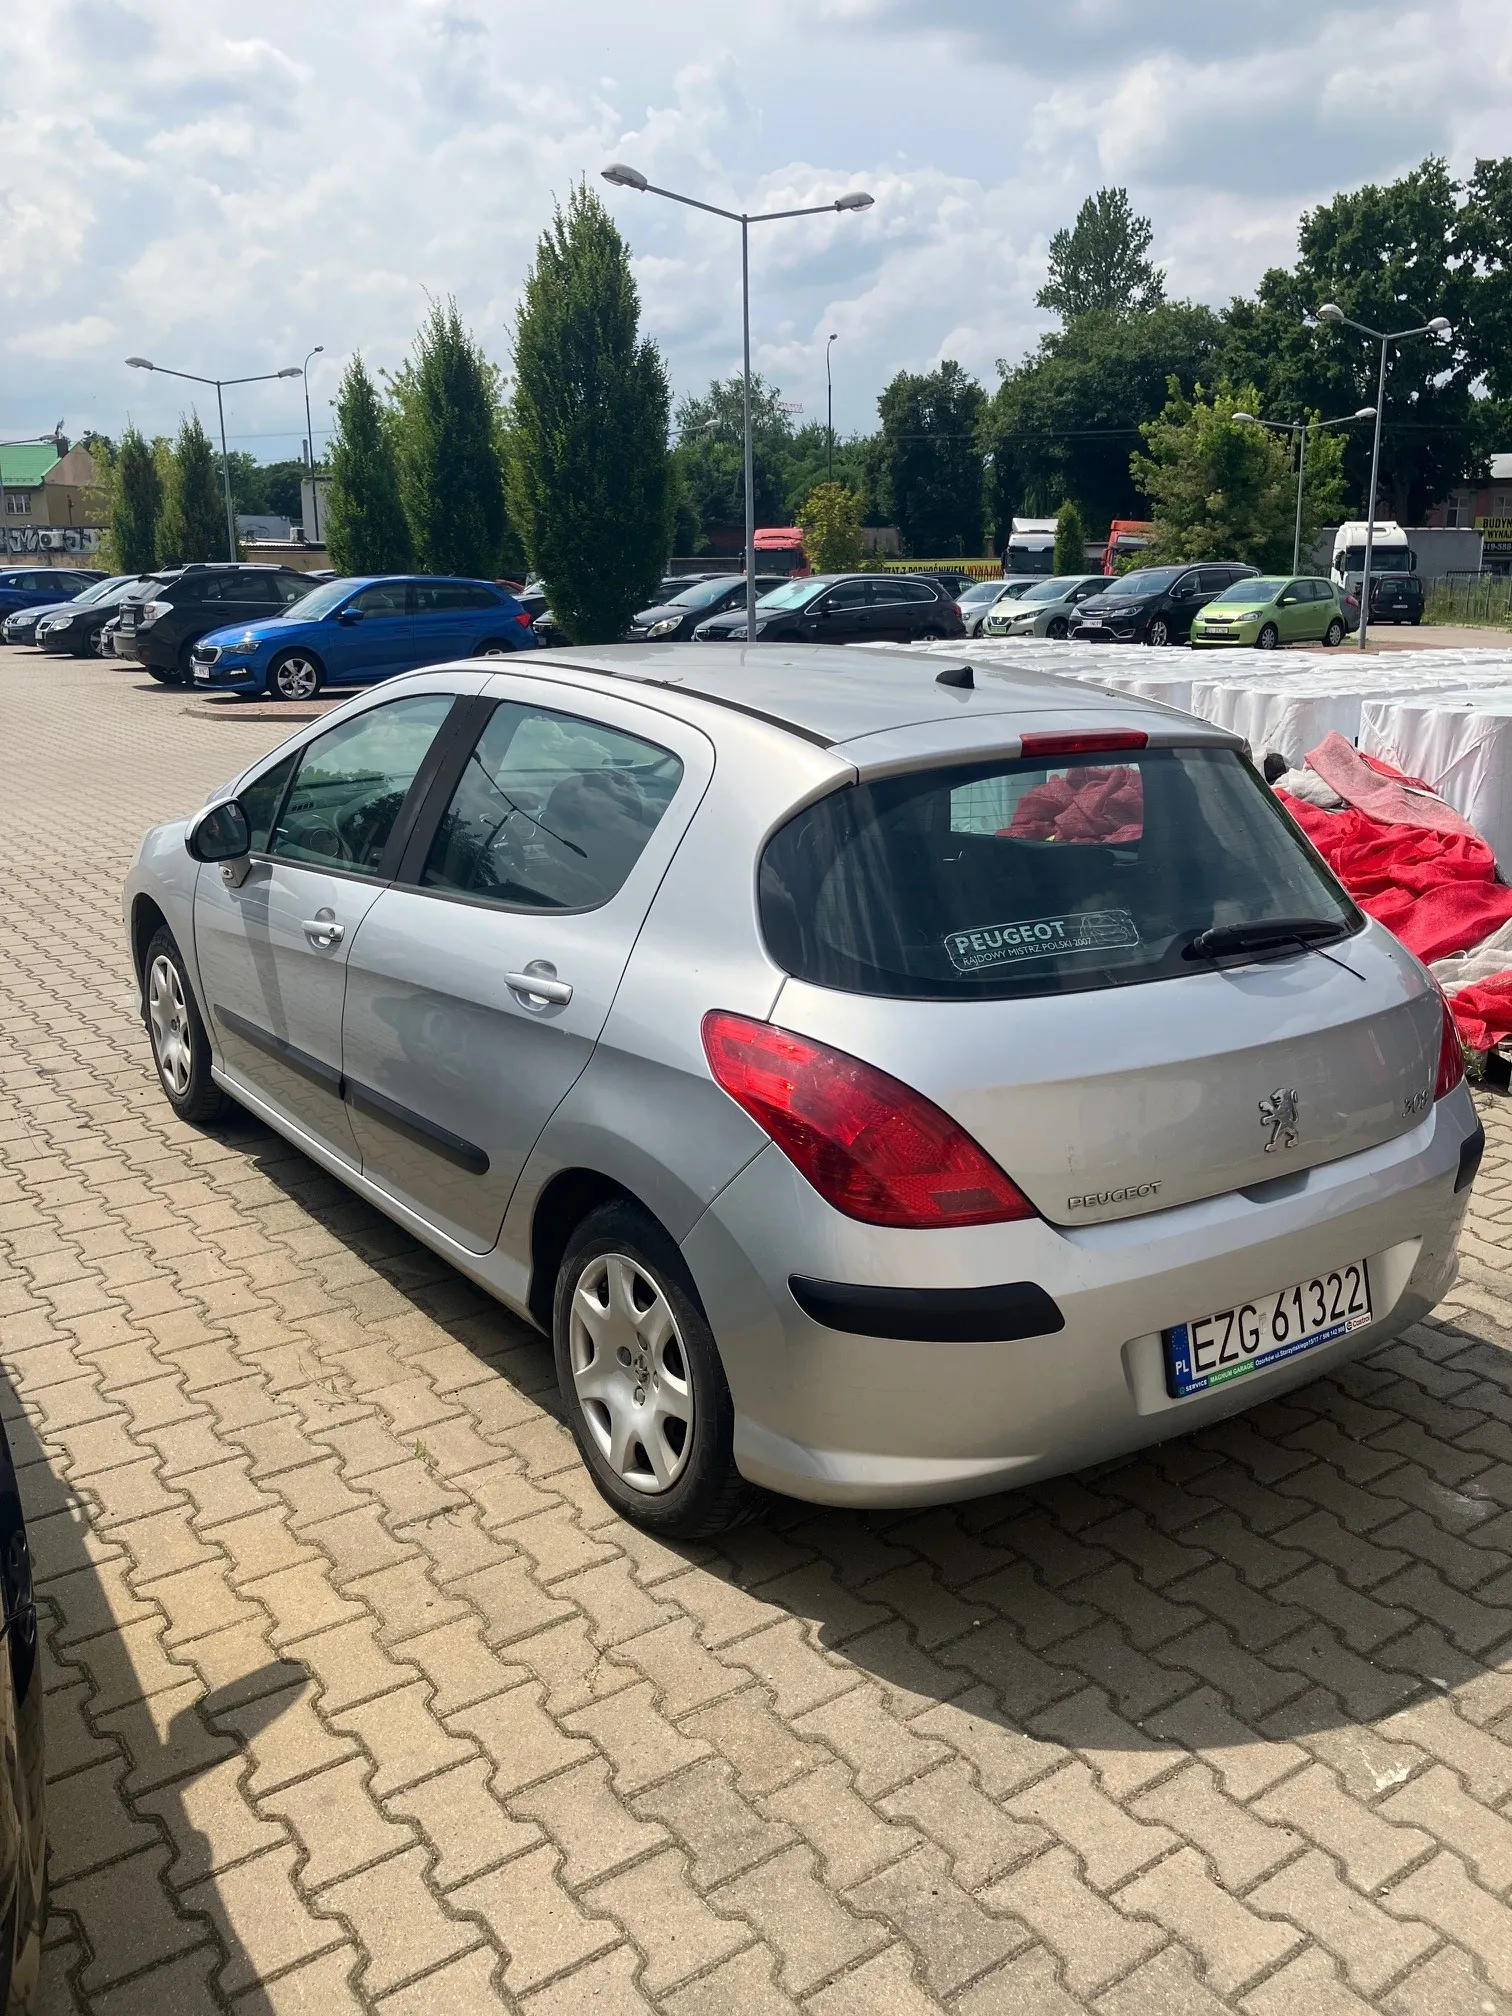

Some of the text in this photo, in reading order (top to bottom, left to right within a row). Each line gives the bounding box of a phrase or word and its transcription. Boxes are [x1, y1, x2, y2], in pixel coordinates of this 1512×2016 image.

[954, 921, 1065, 954] PEUGEOT
[963, 937, 1091, 967] RAJDOWY MISTRZ POLSKI 2007
[1400, 1087, 1429, 1118] 308
[1068, 1181, 1162, 1209] PEUGEOT
[1192, 1266, 1364, 1373] EZG 61322
[1175, 1359, 1190, 1375] PL
[1185, 1379, 1208, 1392] SERVICE
[1210, 1370, 1233, 1383] MAGNUM
[1233, 1361, 1255, 1375] GARAGE
